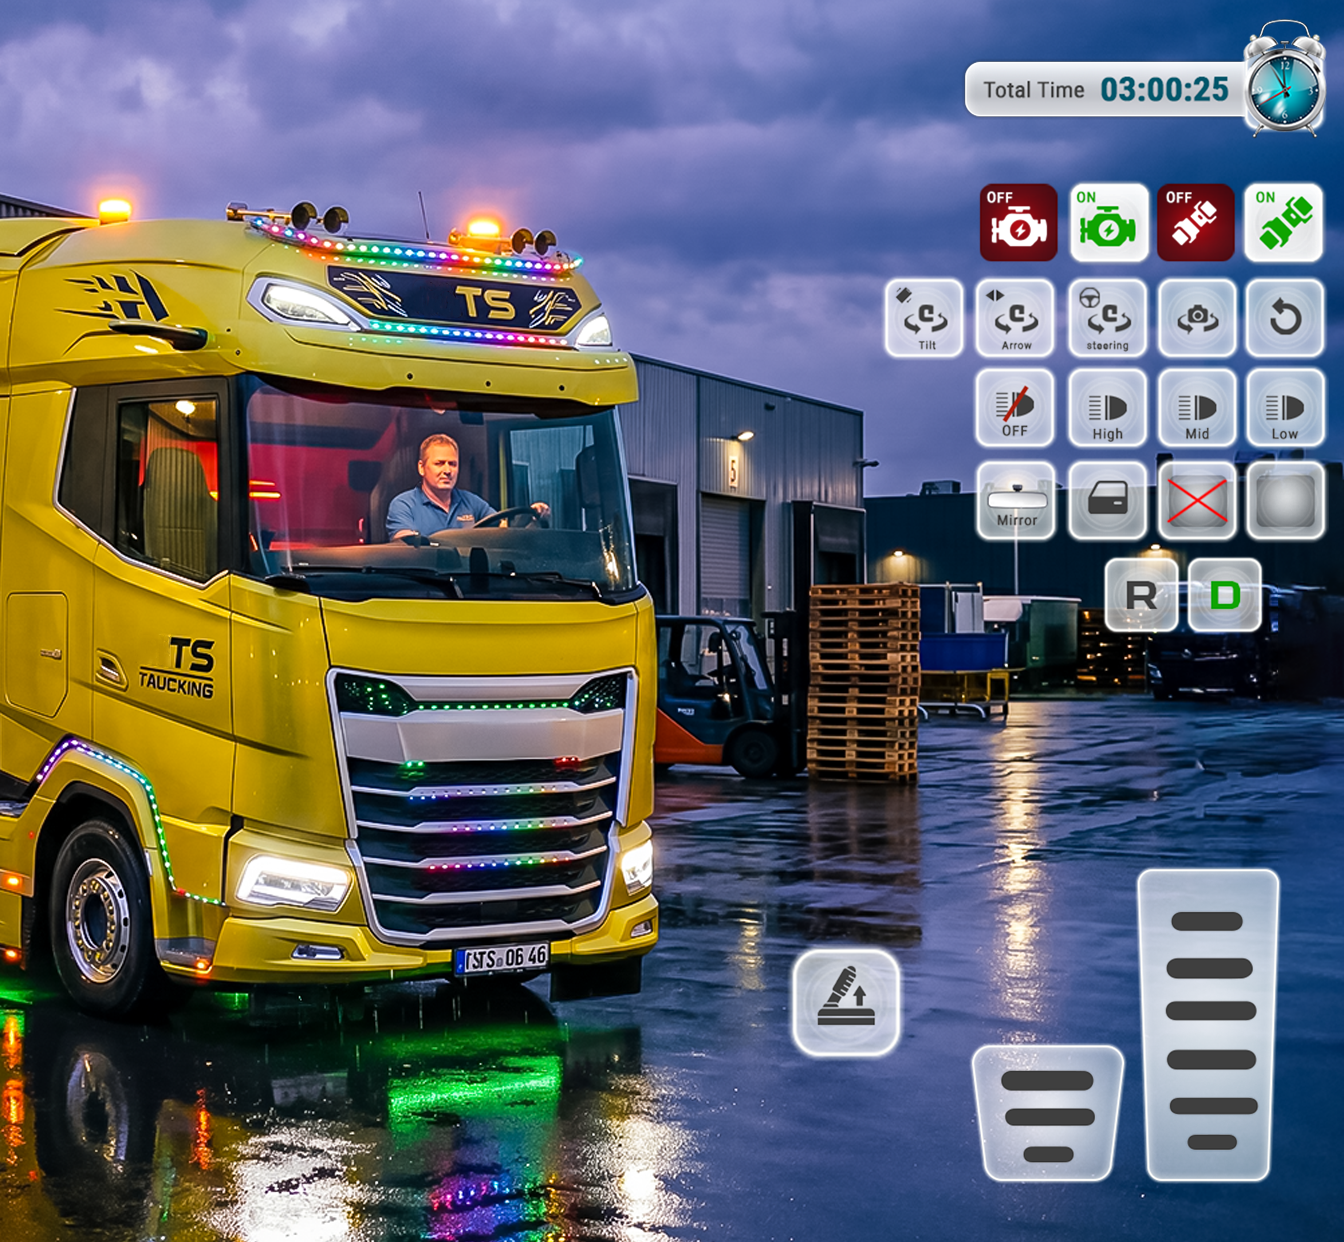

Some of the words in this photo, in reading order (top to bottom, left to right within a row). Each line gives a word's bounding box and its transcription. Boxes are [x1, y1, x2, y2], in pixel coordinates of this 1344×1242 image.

[455, 285, 516, 320] TS
[170, 636, 215, 673] TS
[139, 672, 214, 700] TAUCKING
